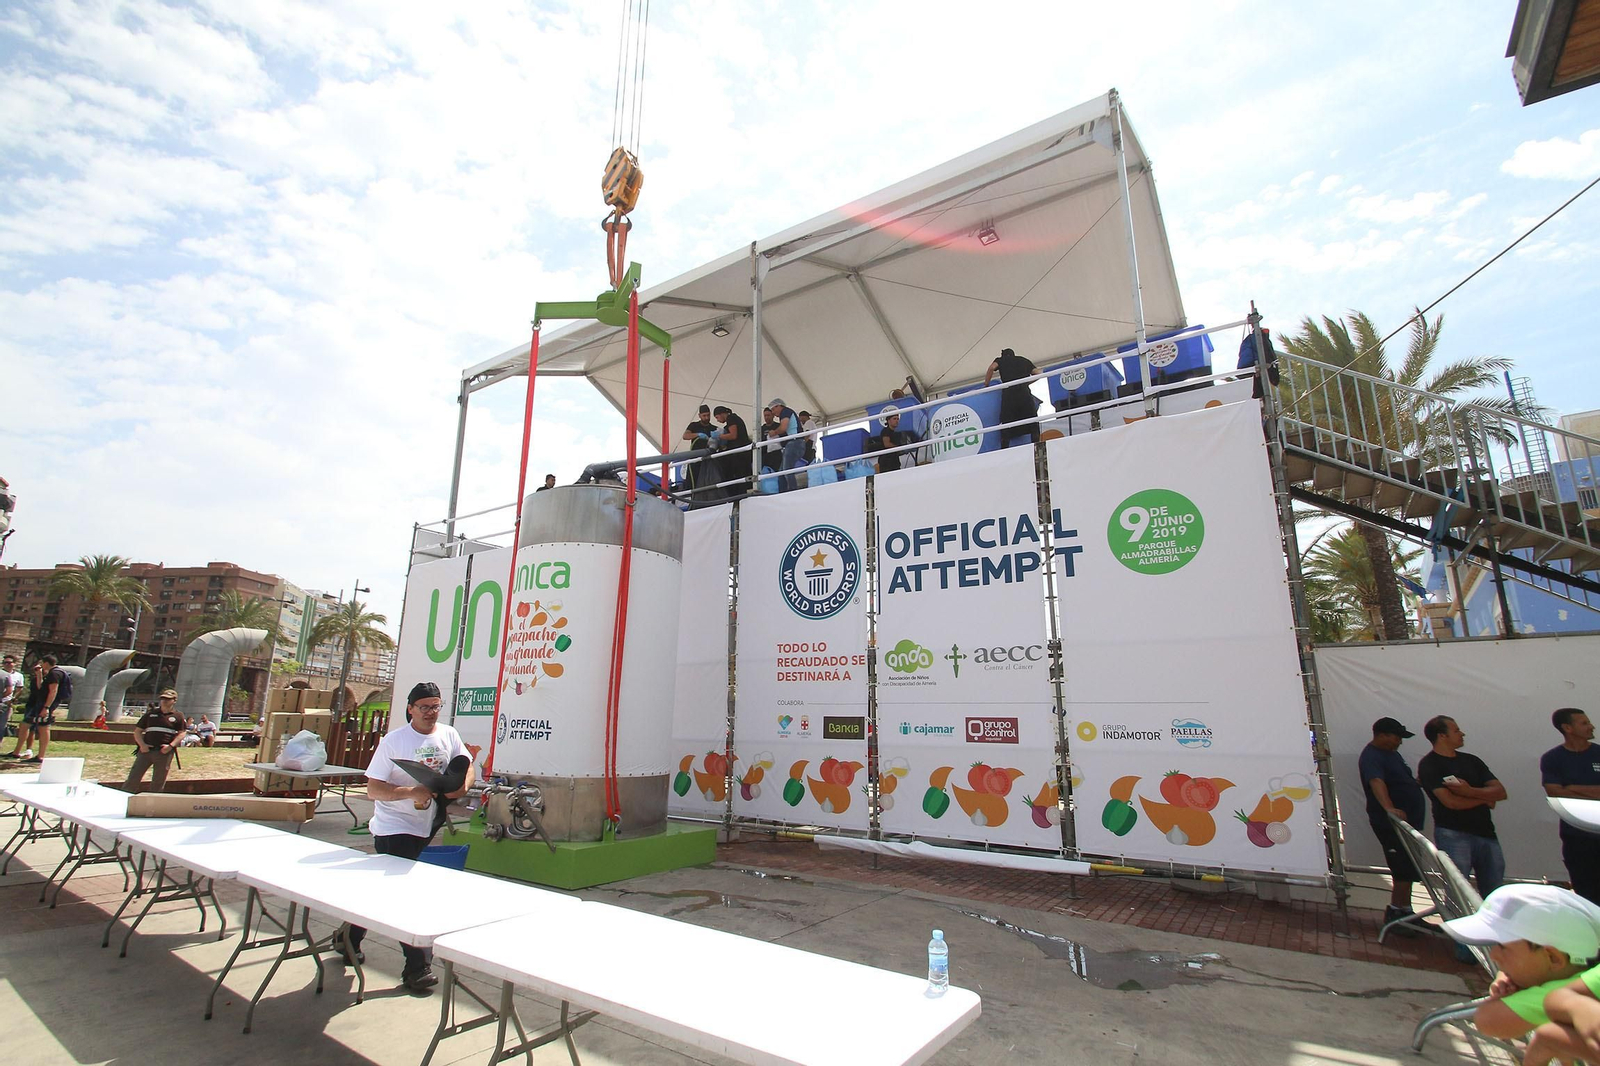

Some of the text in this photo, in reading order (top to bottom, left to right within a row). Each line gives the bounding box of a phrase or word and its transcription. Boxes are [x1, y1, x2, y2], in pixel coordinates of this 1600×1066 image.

[1061, 372, 1085, 385] unica
[944, 412, 969, 423] OFFICIAL
[944, 417, 970, 428] ATTEMPT
[1119, 506, 1169, 543] 9 DE
[1150, 513, 1195, 528] JUNIO
[884, 508, 1078, 560] OFFICIAL
[1152, 525, 1187, 539] 2019
[790, 530, 849, 558] GUINNESS
[1138, 540, 1176, 551] PARQUE
[1120, 545, 1197, 560] ALMADRABILLAS
[1138, 554, 1180, 566] ALMERÍA
[888, 545, 1084, 594] ATTEMPT
[783, 561, 856, 614] WORLD RECORDS
[518, 618, 526, 630] el
[513, 642, 555, 666] grande
[777, 642, 827, 654] TODO LO
[973, 645, 1043, 664] aecc
[508, 660, 538, 675] mundo
[777, 654, 866, 668] RECAUDADO SE
[777, 667, 852, 682] DESTINARÁ A
[472, 690, 497, 702] fund
[510, 719, 552, 730] OFFICIAL
[828, 722, 860, 734] Bankia
[913, 723, 955, 736] cajamar
[983, 721, 1012, 730] grupo
[509, 730, 552, 741] ATTEMPT
[984, 728, 1017, 738] control
[1102, 730, 1162, 741] INDAMOTOR
[1170, 728, 1213, 736] PAELLAS
